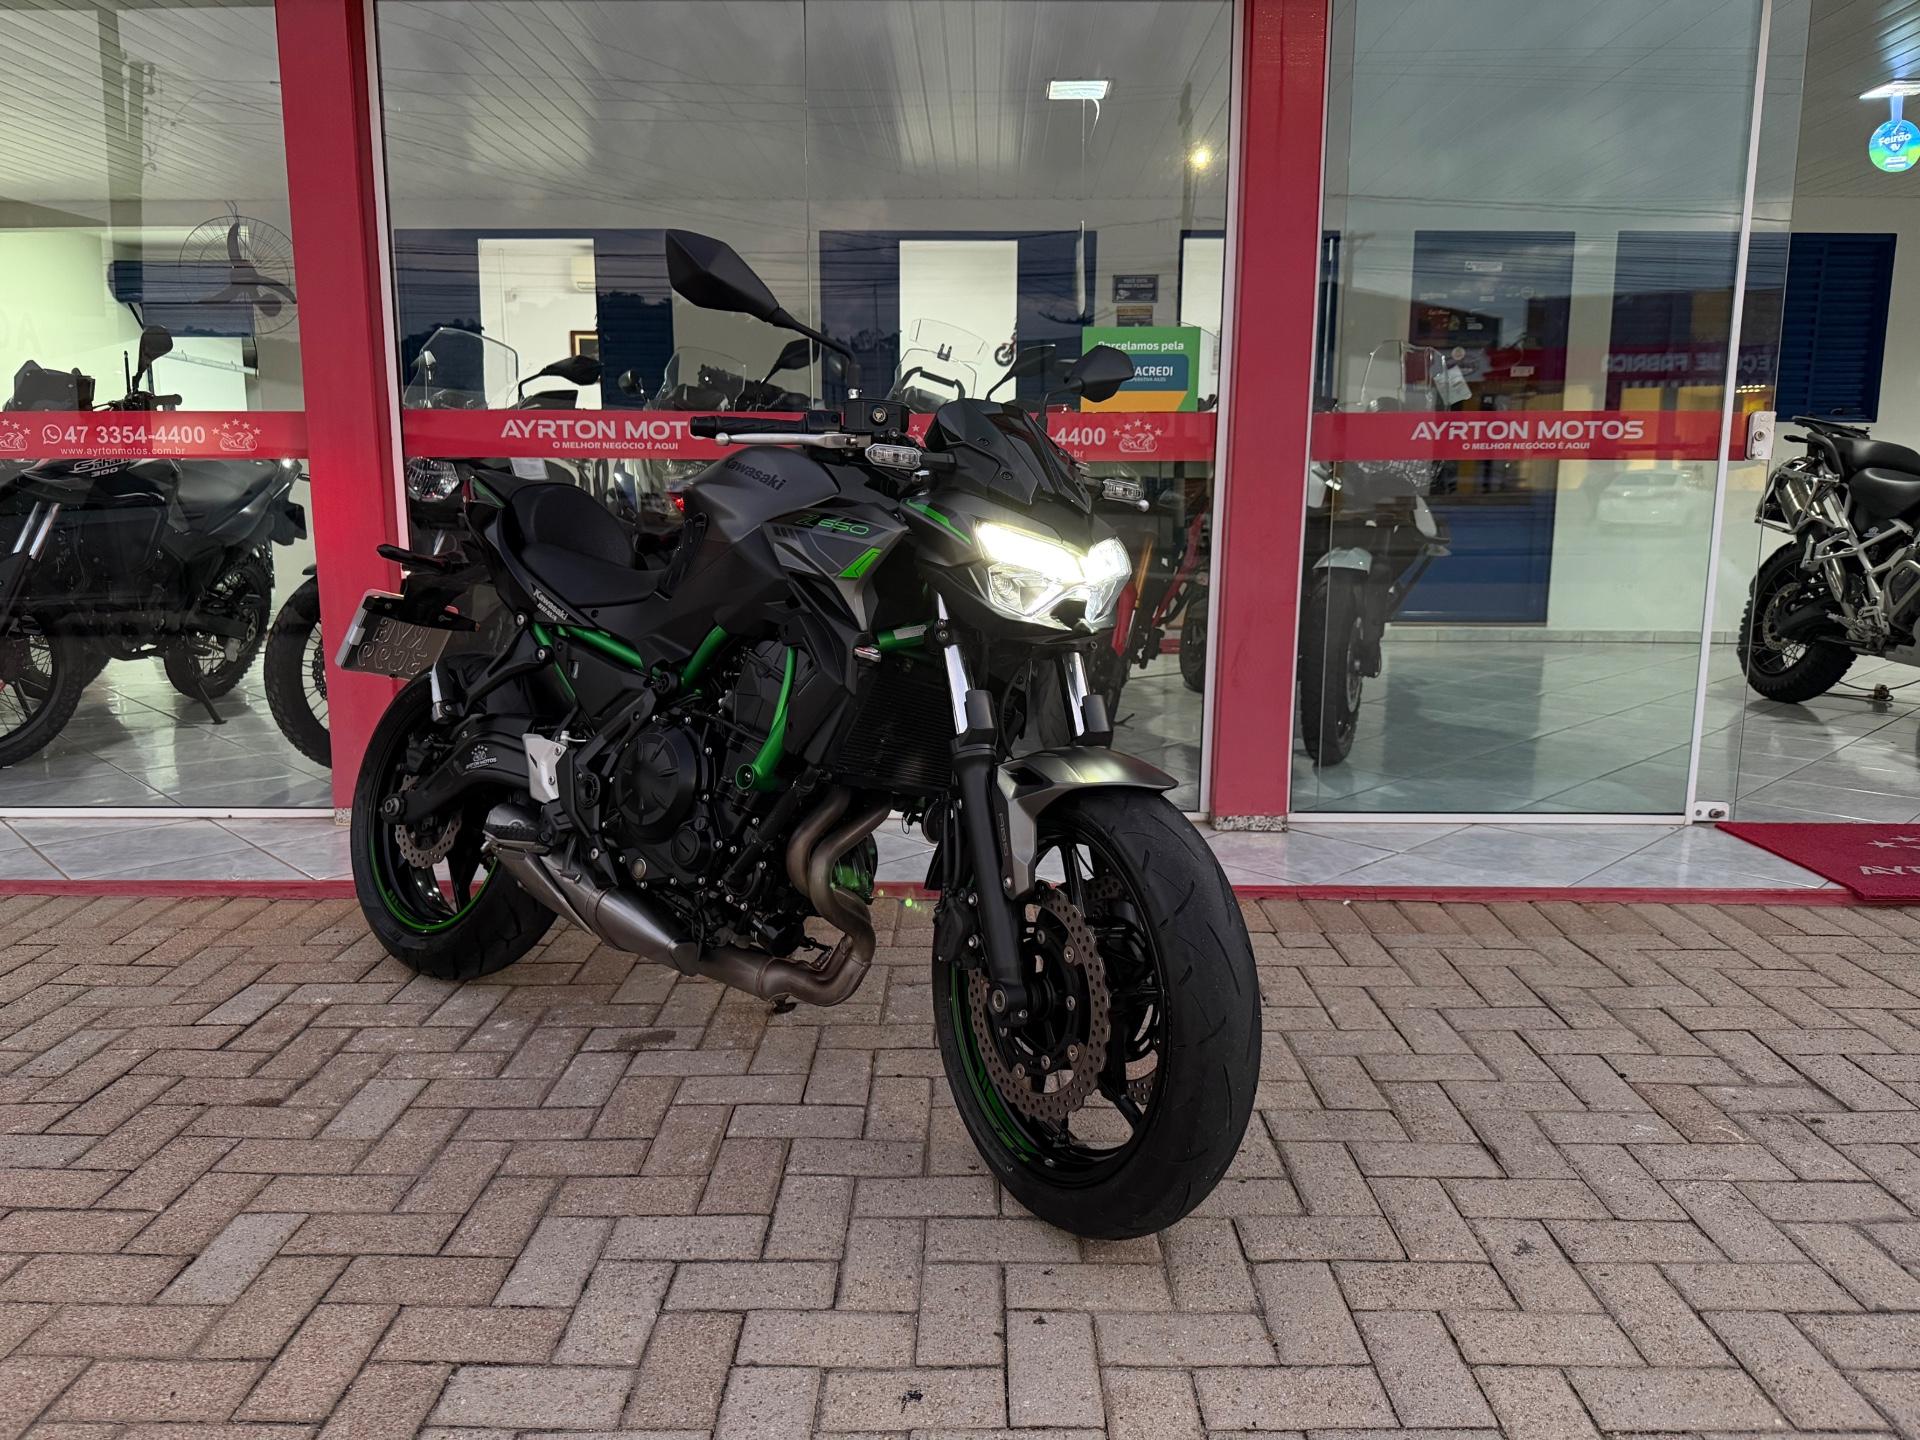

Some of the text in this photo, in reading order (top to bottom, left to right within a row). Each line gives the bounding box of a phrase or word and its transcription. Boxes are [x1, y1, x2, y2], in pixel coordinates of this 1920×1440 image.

[1161, 341, 1184, 353] pela
[1134, 366, 1174, 377] ACREDI
[64, 425, 206, 444] 47 3354-4400
[501, 419, 705, 440] AYRTON MOT
[1410, 421, 1644, 440] AYRTON MOTOS
[1049, 427, 1106, 446] -4400
[60, 446, 185, 457] www.ayrtonmotos.com.br
[602, 441, 645, 449] NEGÓCIO
[646, 441, 652, 449] É
[654, 442, 679, 450] AQUI
[1513, 442, 1556, 450] NEGÓCIO
[1557, 441, 1564, 450] É
[1565, 443, 1590, 451] AQUI
[90, 467, 119, 478] 300
[533, 588, 569, 621] Kawasaki
